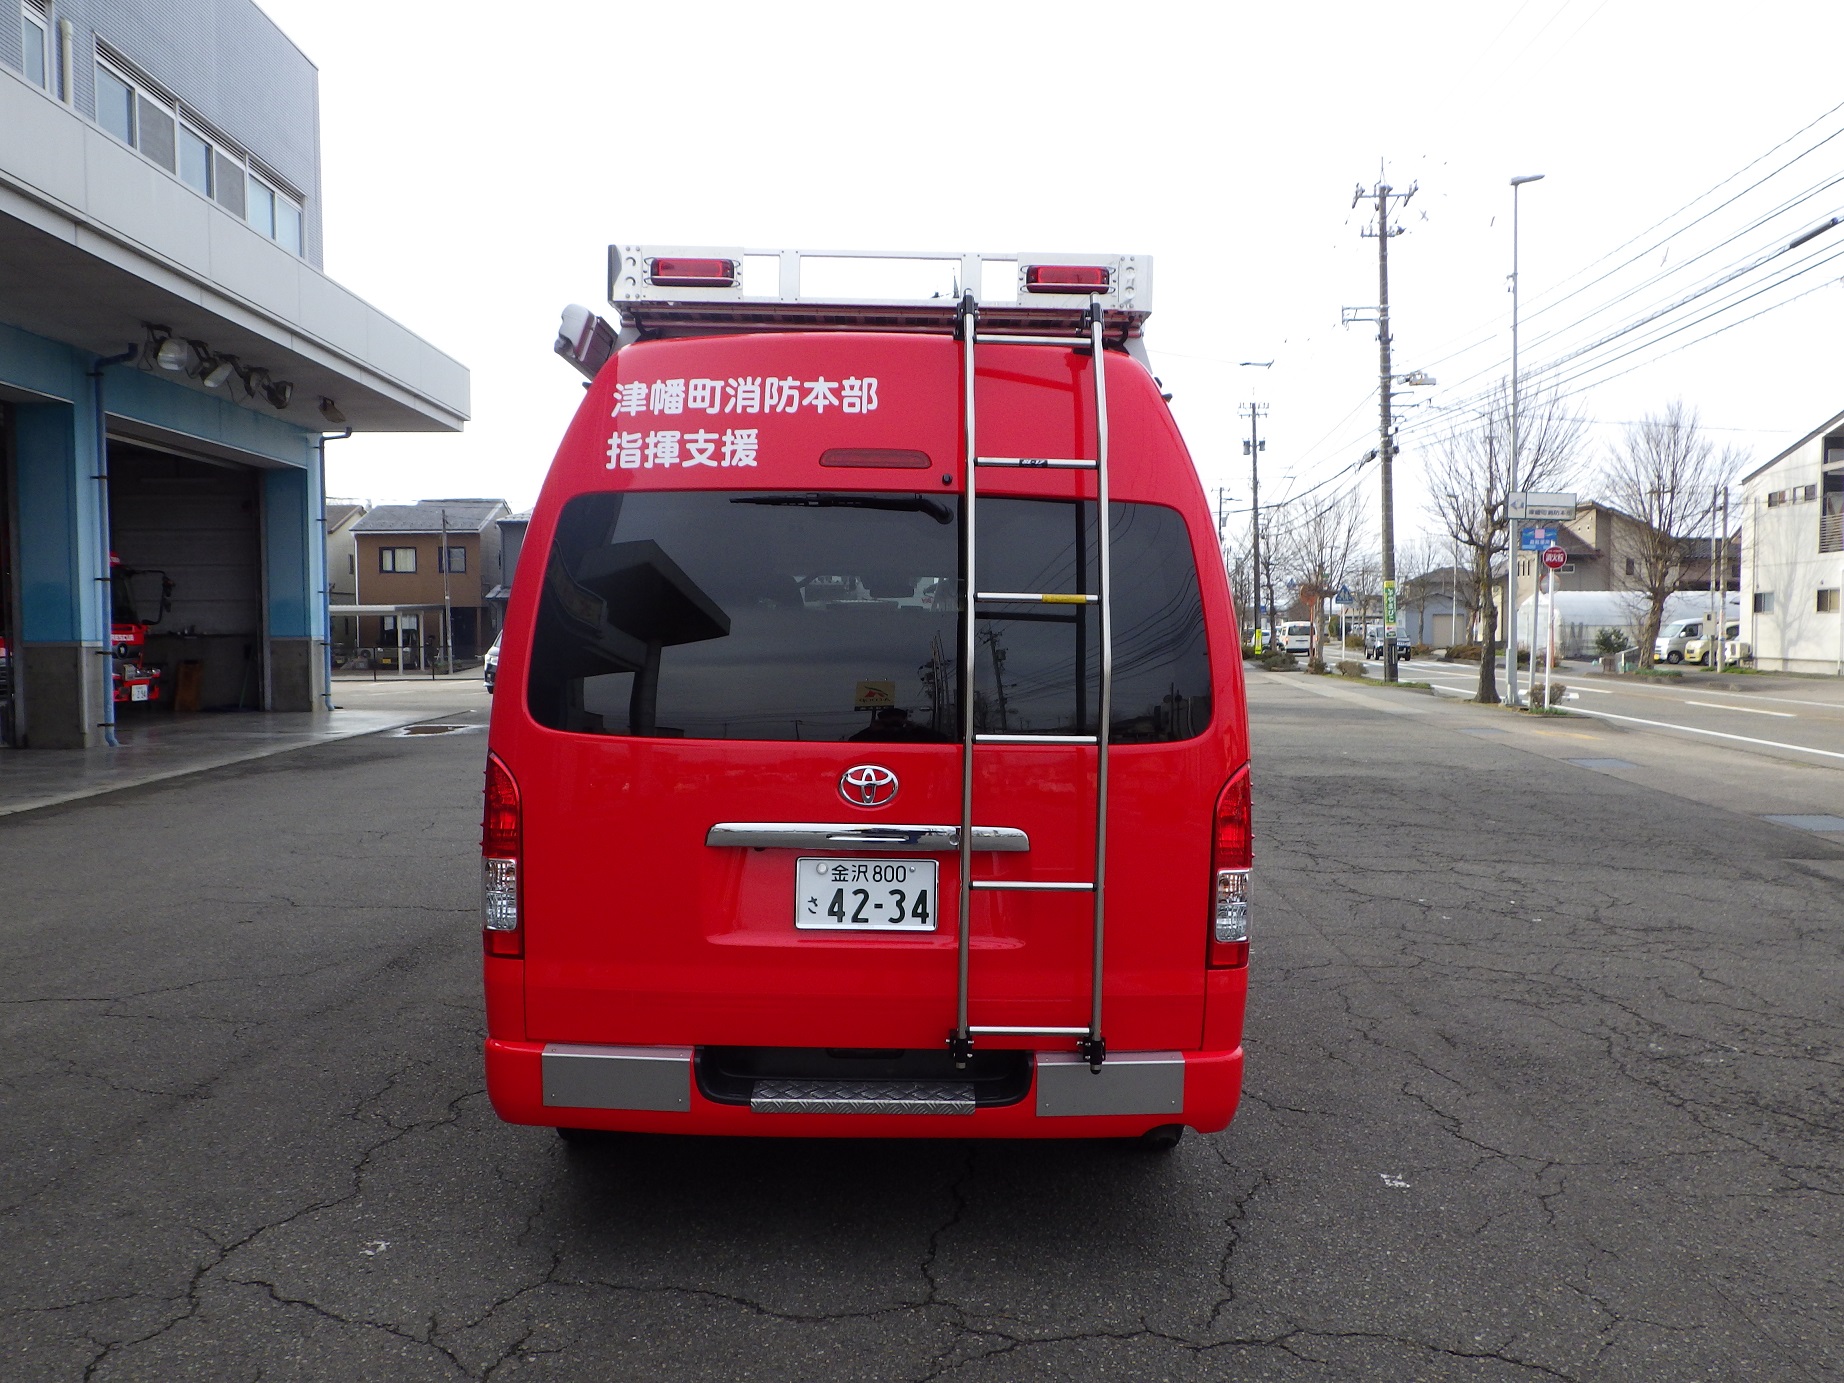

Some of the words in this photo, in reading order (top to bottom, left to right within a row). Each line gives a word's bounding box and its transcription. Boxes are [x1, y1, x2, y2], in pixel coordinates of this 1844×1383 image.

[611, 376, 878, 417] 津幡町消防本部
[605, 428, 758, 469] 指揮支援
[807, 896, 819, 914] さ
[827, 887, 930, 924] 42-34
